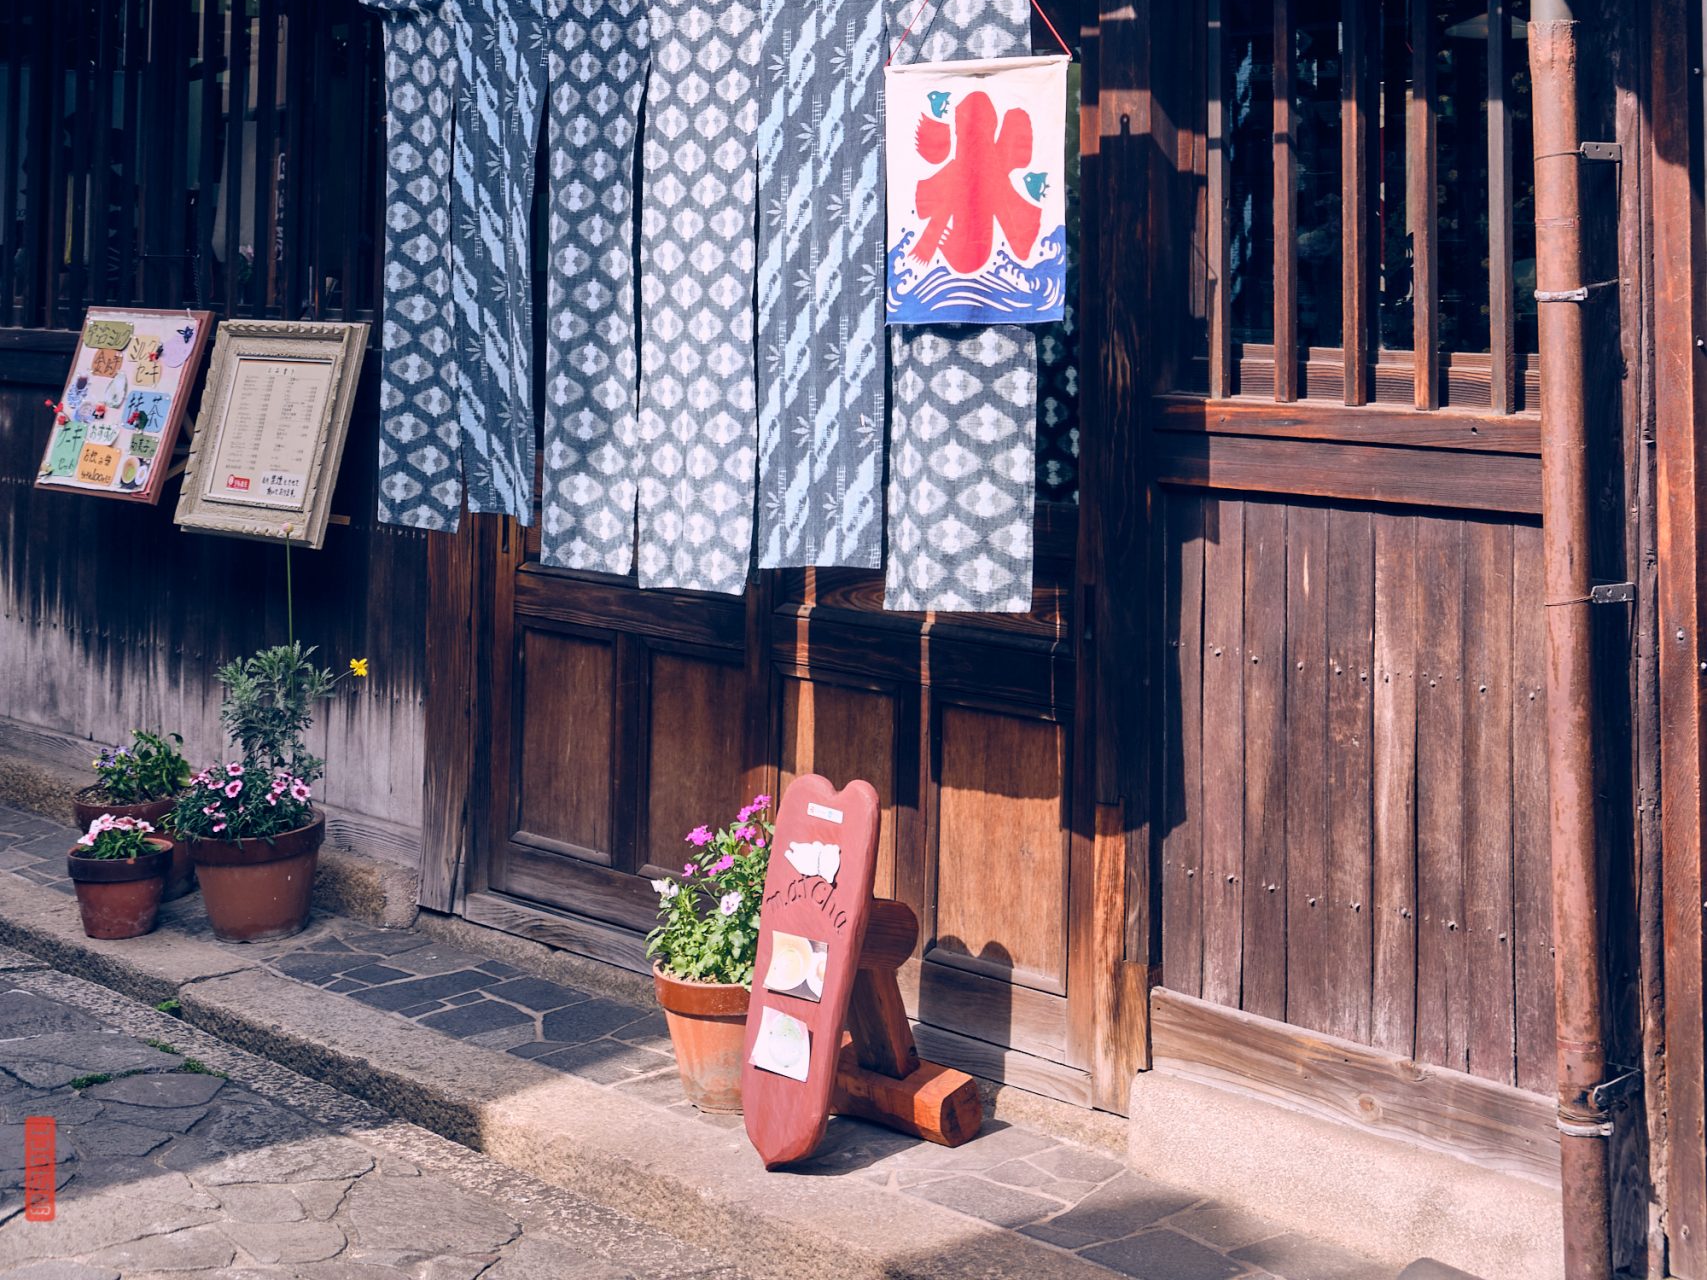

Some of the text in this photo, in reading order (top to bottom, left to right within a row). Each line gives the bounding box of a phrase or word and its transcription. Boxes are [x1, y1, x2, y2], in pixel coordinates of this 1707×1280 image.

[908, 90, 1043, 274] 氷
[136, 363, 159, 383] セーキ
[56, 426, 82, 452] ケーキ
